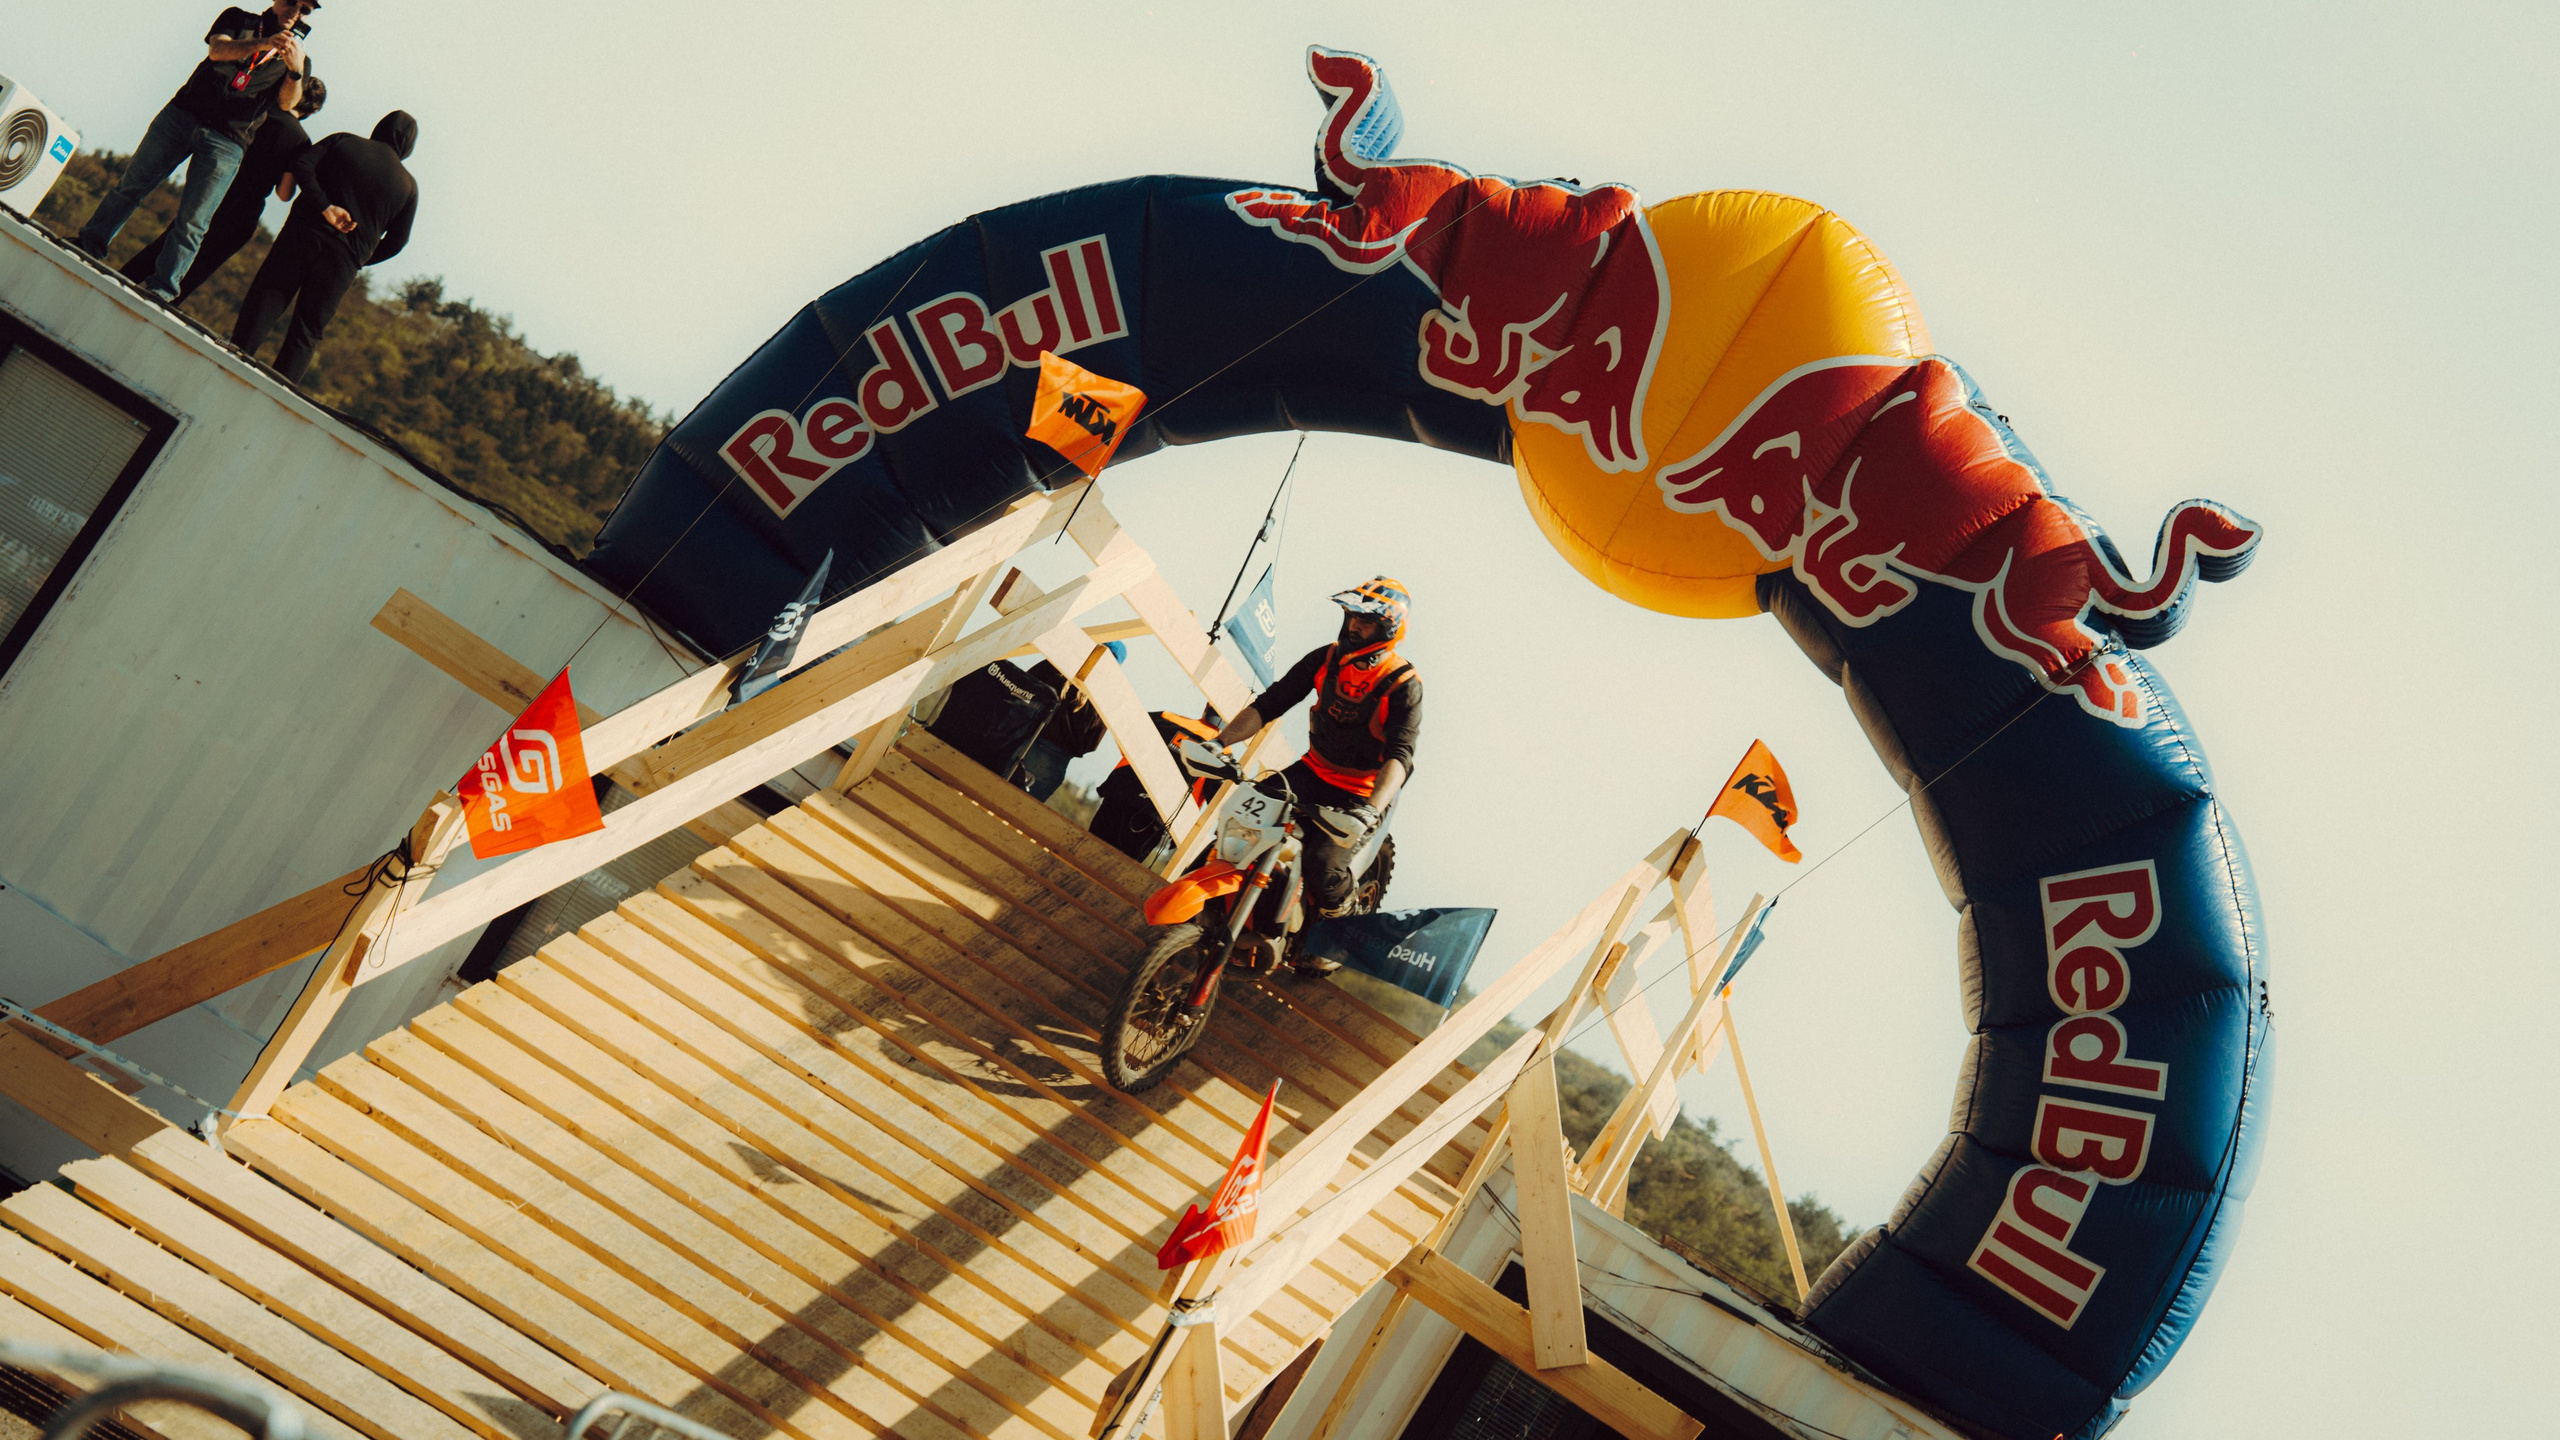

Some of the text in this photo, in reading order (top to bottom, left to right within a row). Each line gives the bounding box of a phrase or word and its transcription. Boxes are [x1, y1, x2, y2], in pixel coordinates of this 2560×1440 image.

[723, 238, 1122, 512] Red Bull
[1241, 796, 1266, 818] 42
[1974, 866, 2162, 1324] Red Bull
